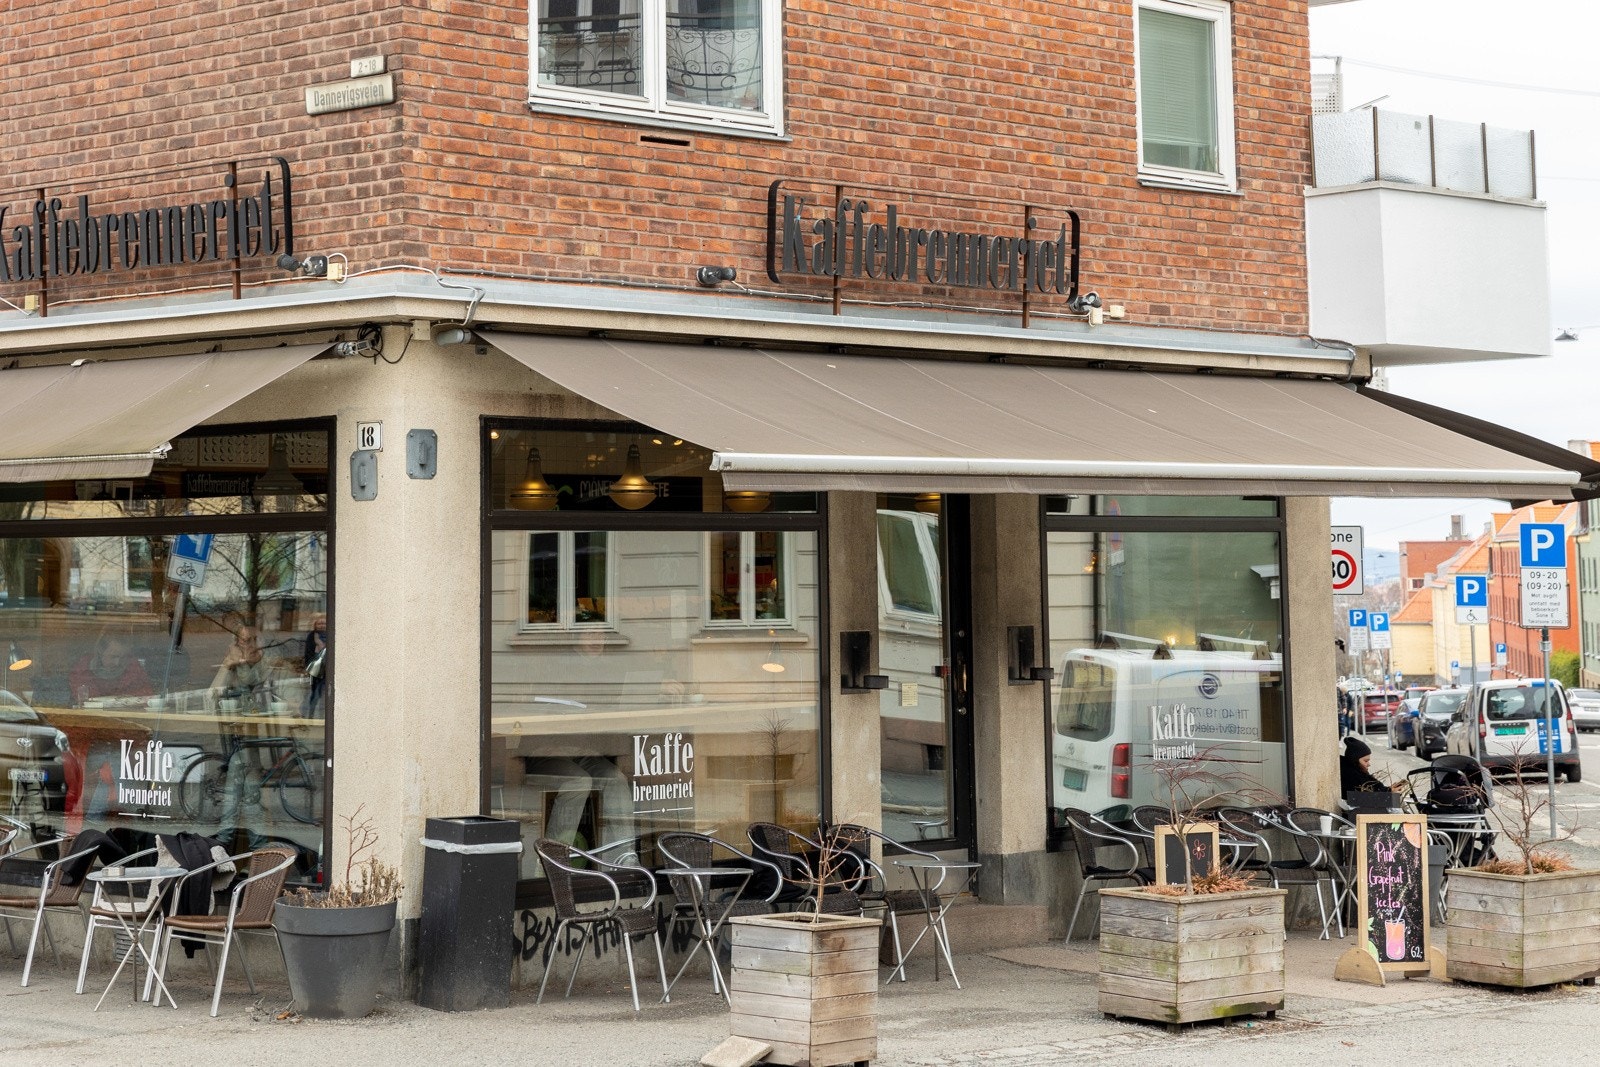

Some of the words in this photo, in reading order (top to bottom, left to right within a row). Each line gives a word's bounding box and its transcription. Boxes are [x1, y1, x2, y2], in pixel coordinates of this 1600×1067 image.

[313, 82, 385, 107] Dannevigsveien
[782, 194, 1071, 294] Kaffebrenneriet
[361, 426, 375, 447] 18
[1331, 533, 1353, 542] one
[1531, 529, 1555, 562] P
[1462, 579, 1480, 603] P
[1353, 611, 1363, 625] P
[1373, 614, 1385, 630] P
[1151, 703, 1196, 741] Kaffe
[119, 739, 173, 783] Kaffe
[633, 732, 694, 777] Kaffe
[1152, 741, 1196, 760] brenneriet
[118, 783, 172, 807] brenneriet
[633, 778, 693, 802] brenneriet
[1376, 841, 1396, 863] Pink
[1368, 865, 1404, 894] Grapefruit
